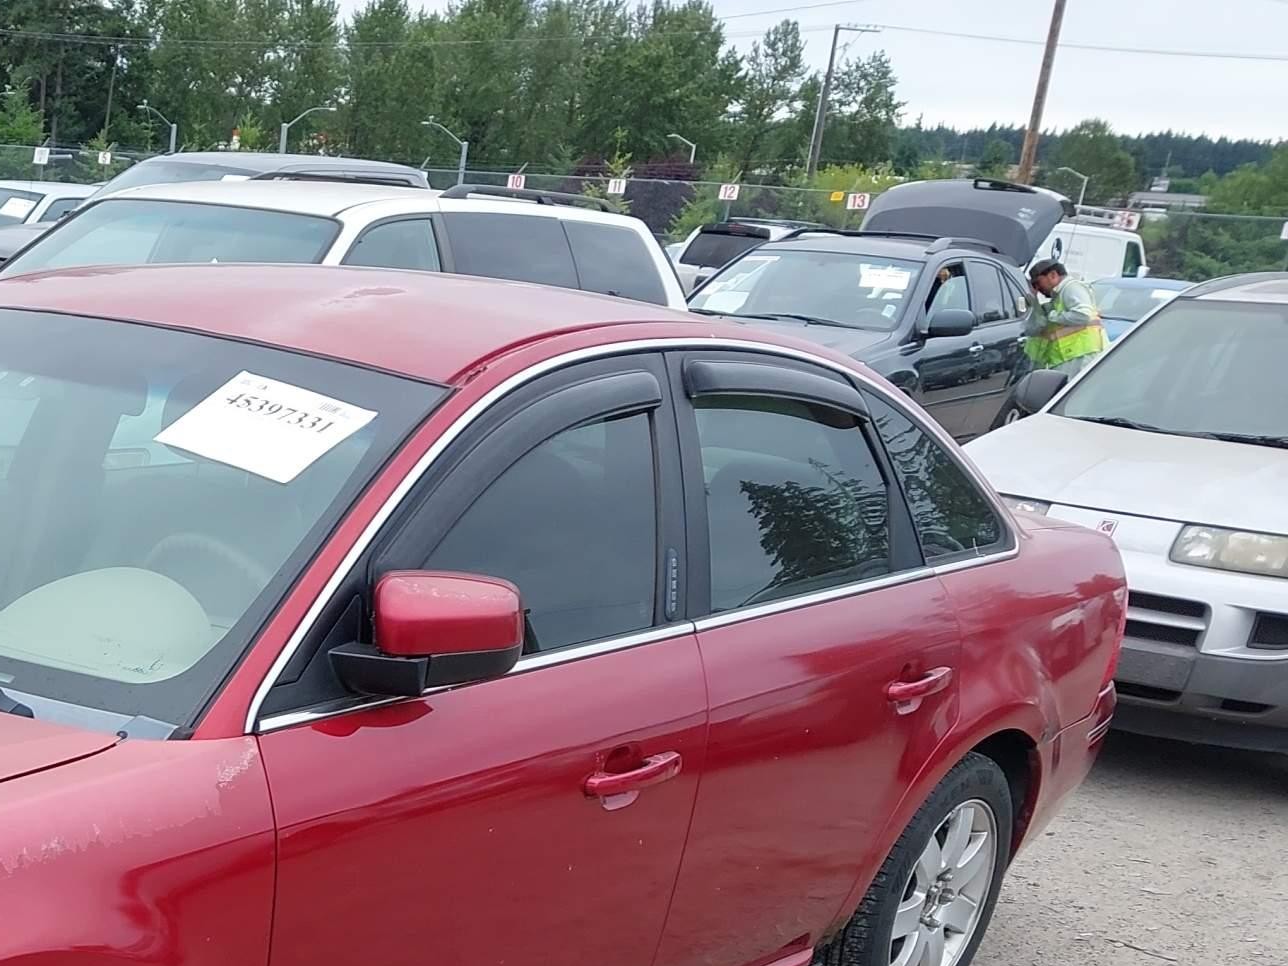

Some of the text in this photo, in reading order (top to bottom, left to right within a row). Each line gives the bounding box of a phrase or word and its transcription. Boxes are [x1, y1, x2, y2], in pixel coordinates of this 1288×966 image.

[511, 175, 522, 188] 10
[612, 180, 622, 192] 11
[723, 185, 736, 199] 12
[852, 194, 866, 208] 13
[225, 392, 335, 434] 45397331
